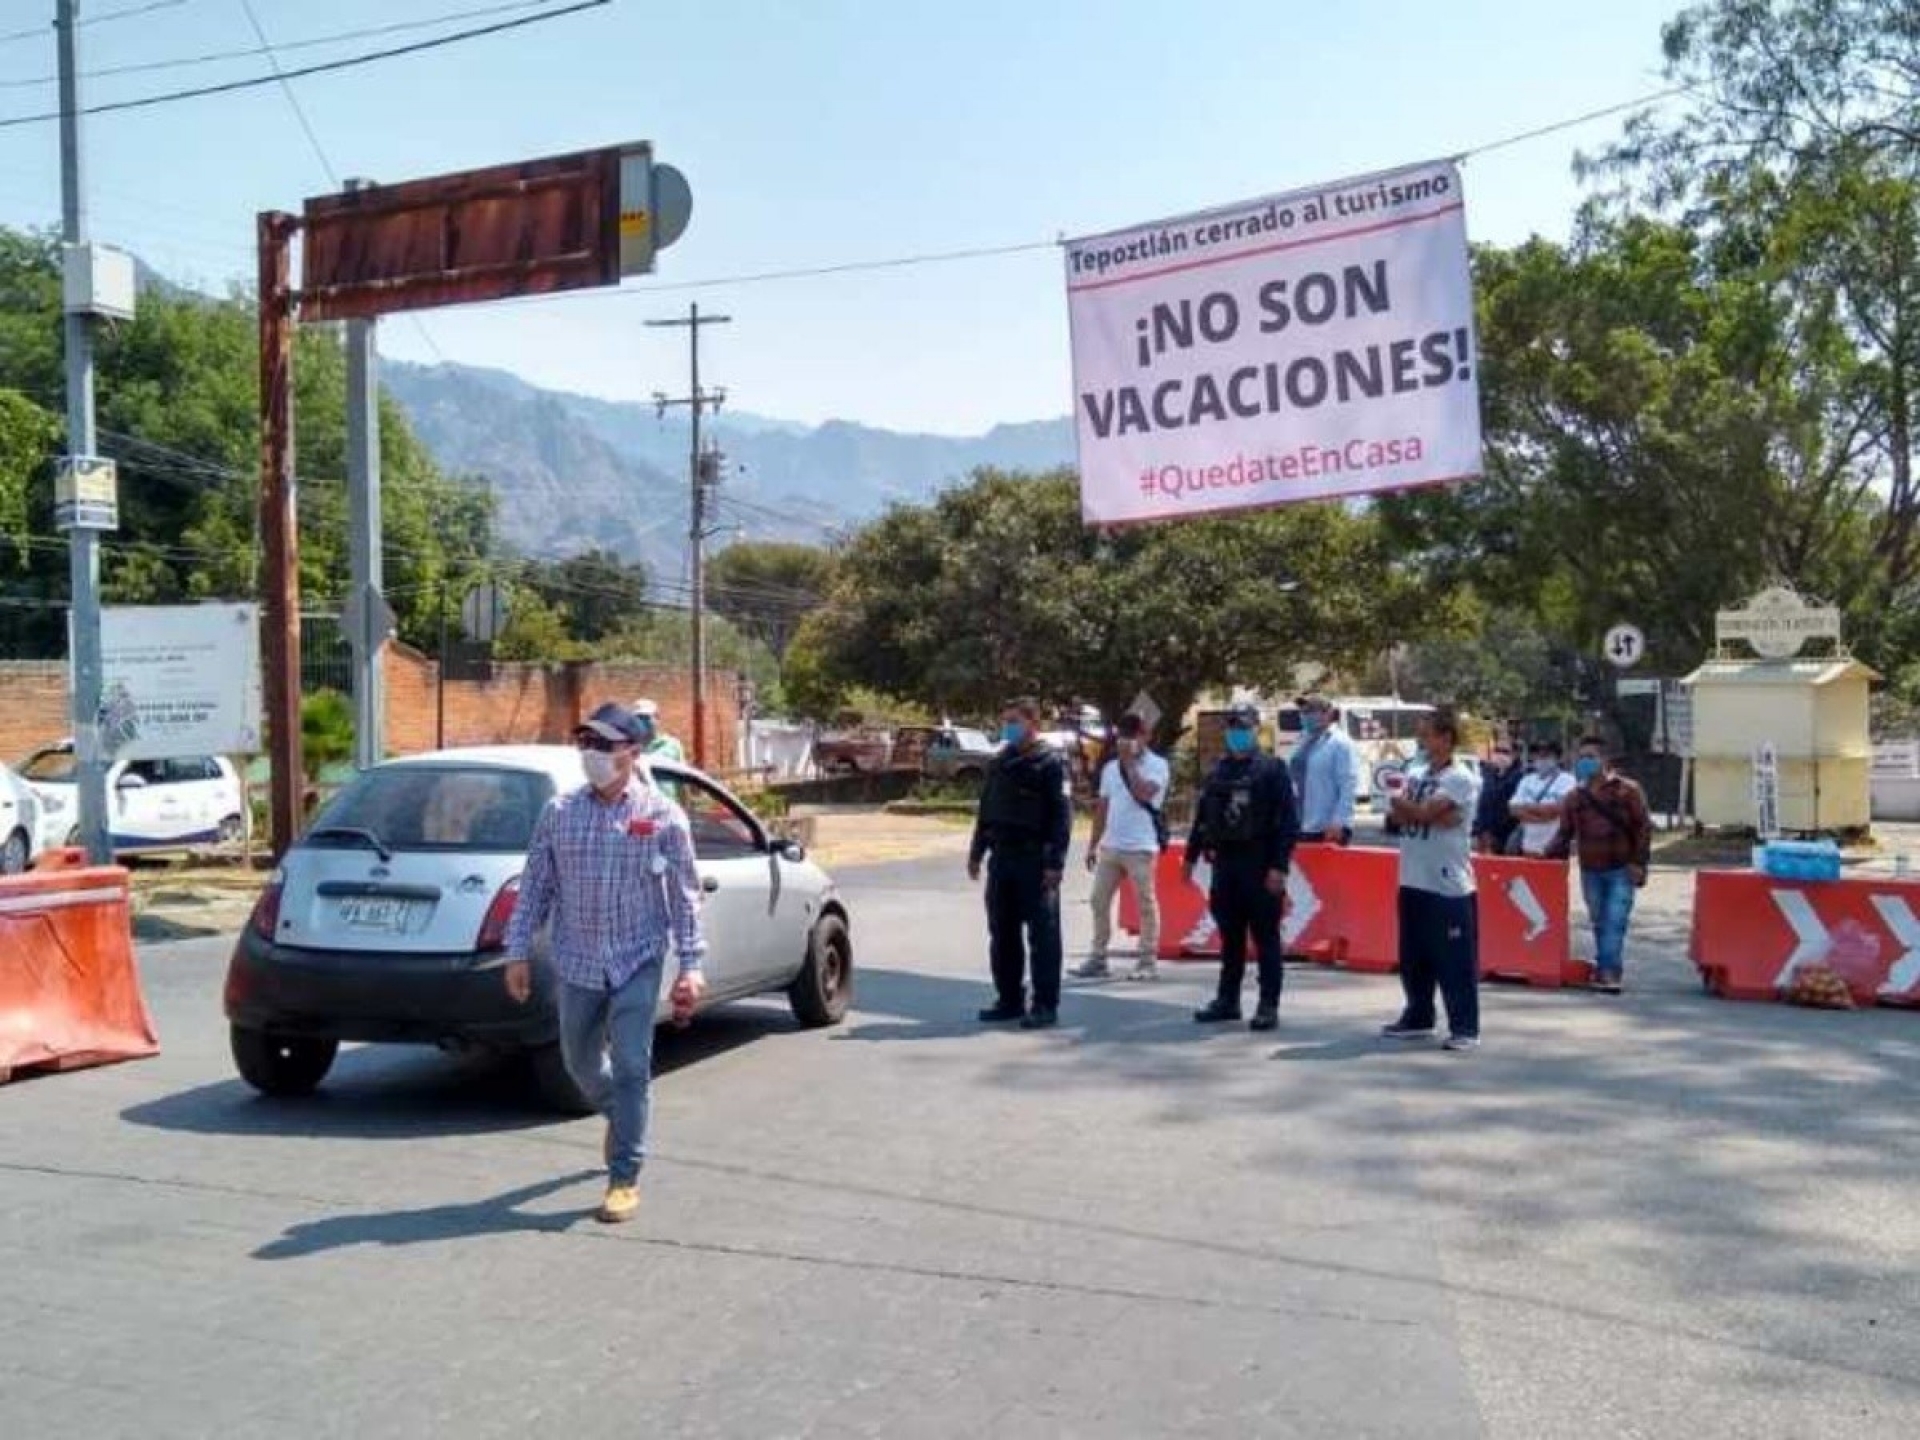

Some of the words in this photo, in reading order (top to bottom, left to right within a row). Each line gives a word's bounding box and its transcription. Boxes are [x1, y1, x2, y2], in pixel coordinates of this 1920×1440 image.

[1070, 229, 1188, 274] Tepoztlán
[1194, 205, 1295, 246] cerrado
[1303, 195, 1328, 223] al
[1334, 174, 1449, 216] turismo
[1136, 291, 1240, 366] ¡NO
[1259, 260, 1391, 333] SON
[1082, 327, 1471, 438] VACACIONES!
[1140, 436, 1423, 498] #QuedateEnCasa
